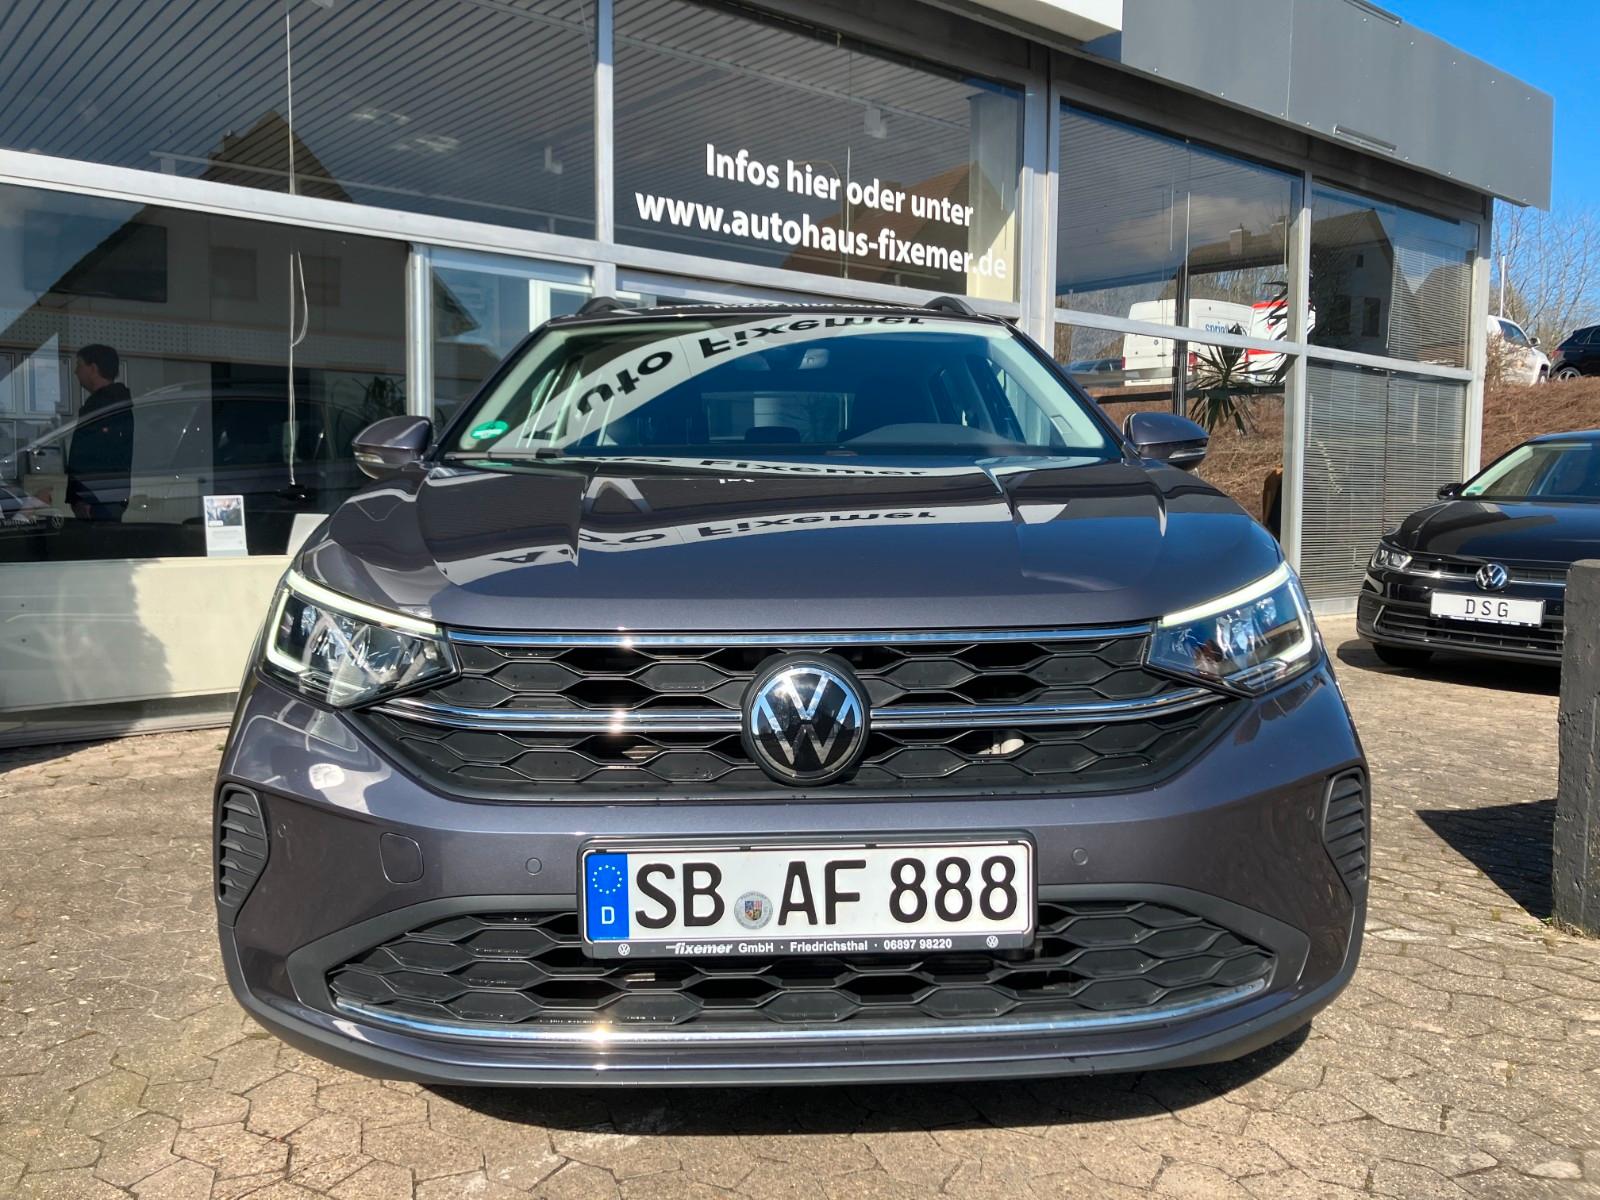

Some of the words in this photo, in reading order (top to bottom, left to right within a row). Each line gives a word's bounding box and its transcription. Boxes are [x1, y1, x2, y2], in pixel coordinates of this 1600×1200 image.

[706, 143, 779, 189] Infos
[787, 159, 841, 200] hier
[847, 177, 905, 213] oder
[911, 194, 974, 227] unter
[635, 191, 1007, 279] www.autohaus-fixemer.de
[751, 667, 861, 778] VW
[600, 906, 615, 925] D
[635, 862, 725, 930] SB
[777, 859, 867, 926] AF
[888, 855, 1017, 924] 888
[666, 942, 733, 954] fixemer
[738, 942, 774, 953] GmbH
[790, 941, 868, 952] Friedrichsthal
[883, 939, 916, 950] 06897
[919, 938, 952, 949] 98220
